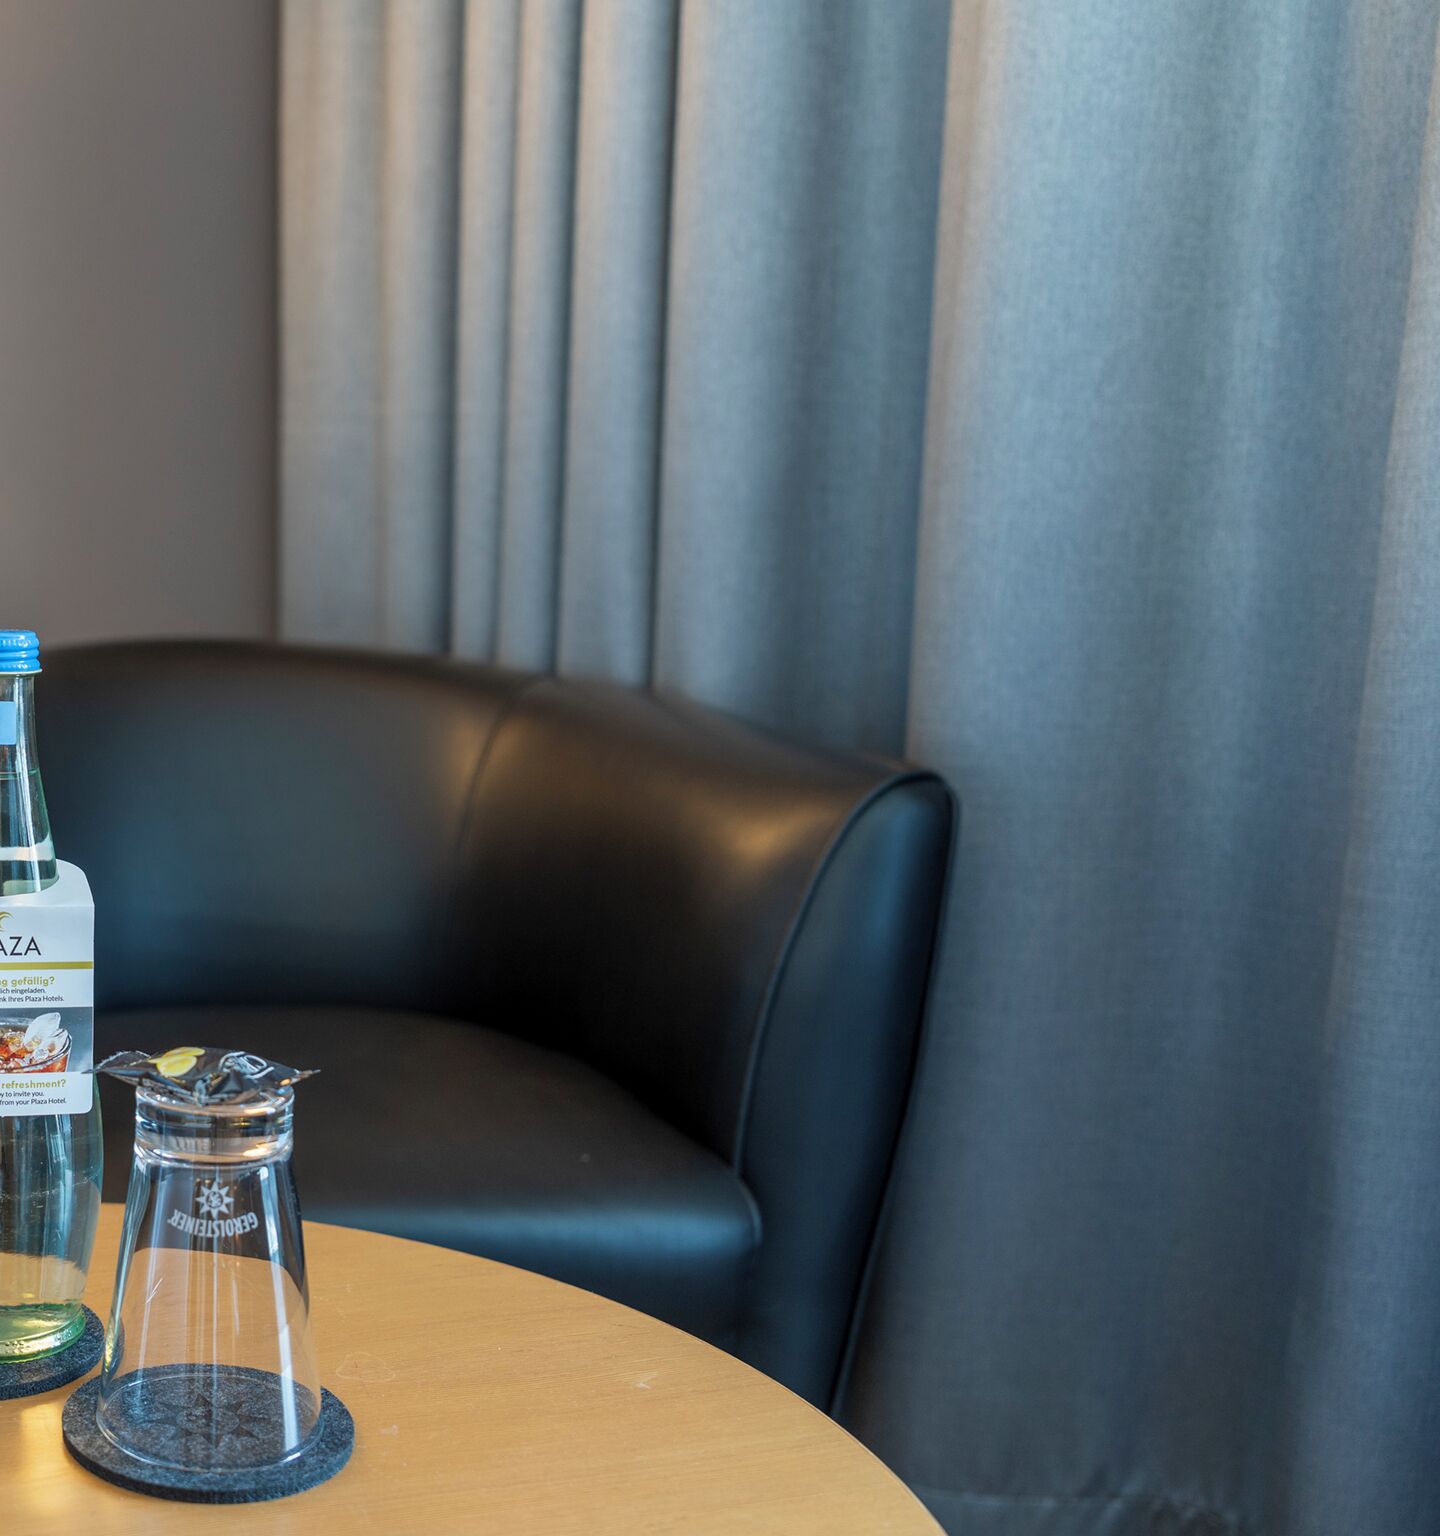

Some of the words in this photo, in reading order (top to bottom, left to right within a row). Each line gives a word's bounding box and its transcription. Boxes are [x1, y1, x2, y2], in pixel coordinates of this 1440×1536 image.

[11, 976, 55, 987] gefällig?
[11, 987, 46, 995] eingeladen.
[1, 1079, 66, 1089] refreshment?
